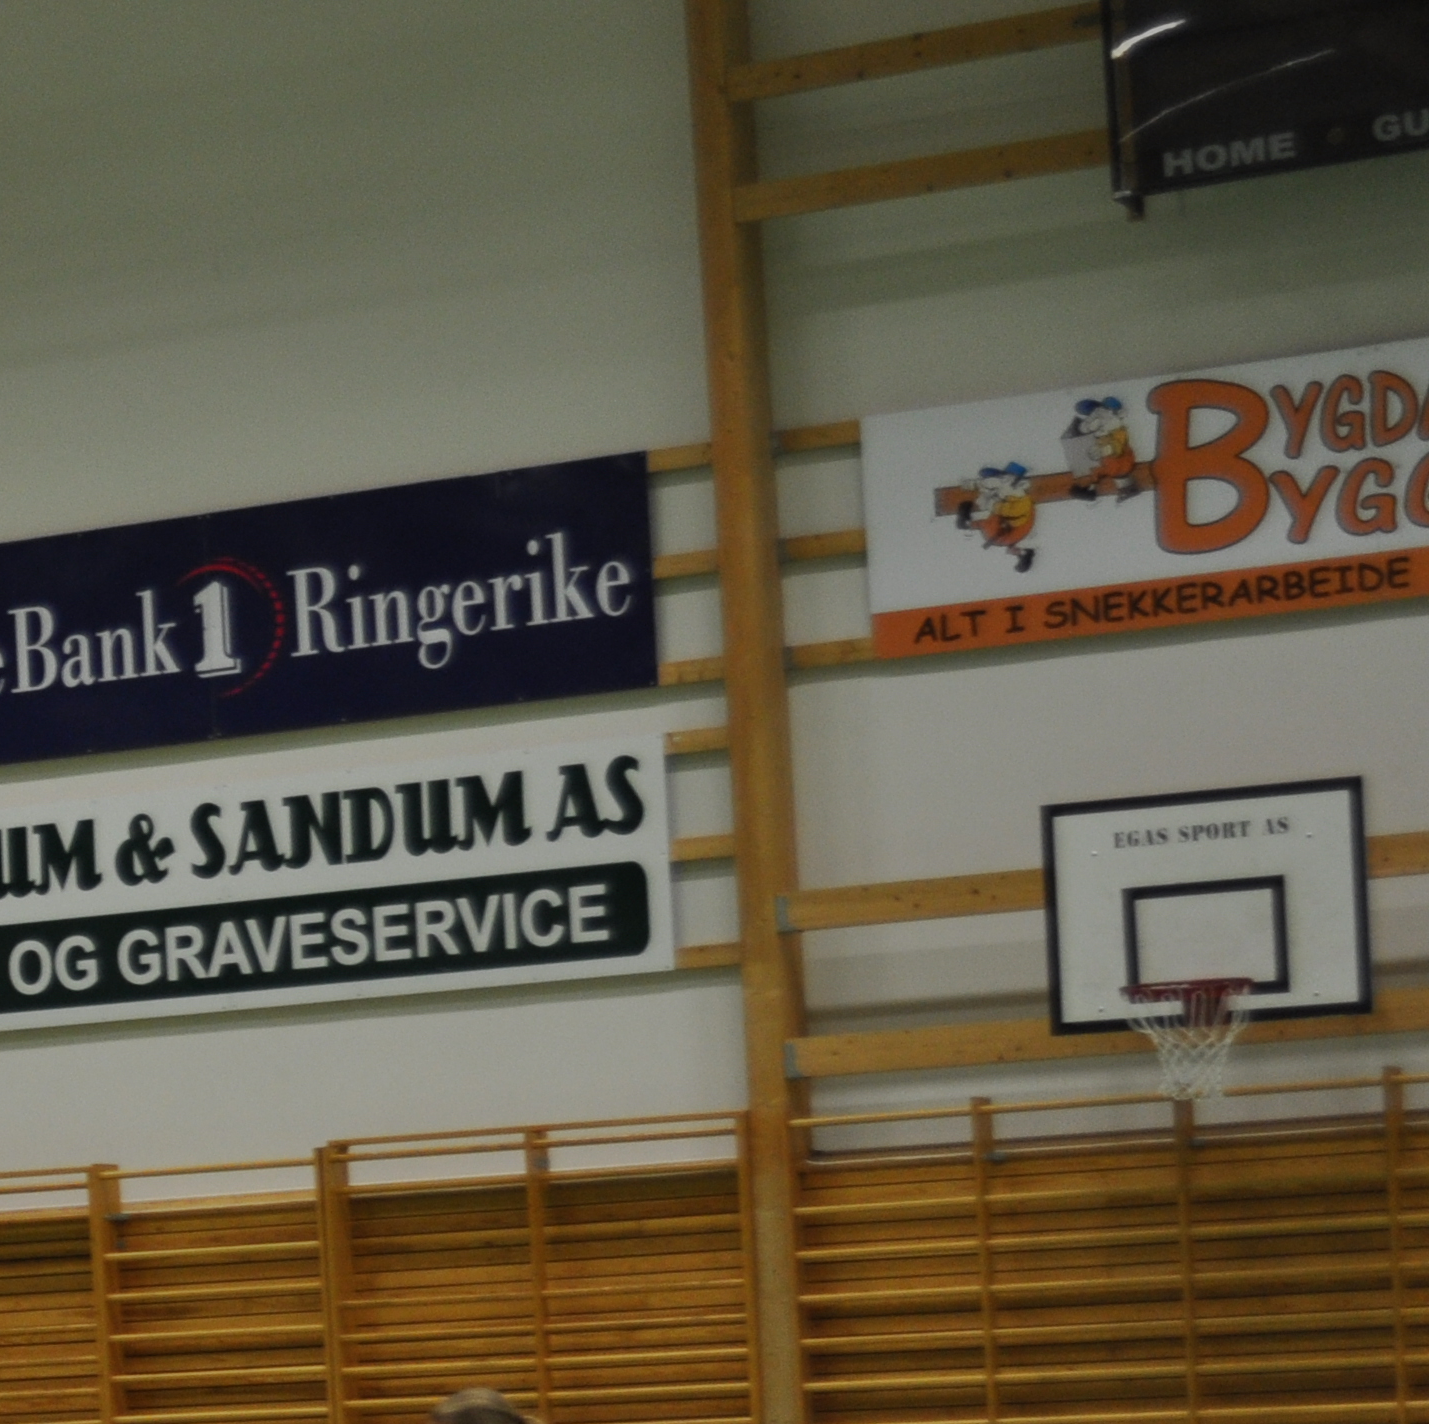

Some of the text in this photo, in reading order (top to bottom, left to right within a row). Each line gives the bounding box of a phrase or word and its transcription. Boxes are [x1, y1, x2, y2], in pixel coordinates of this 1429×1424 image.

[1162, 132, 1296, 178] HOME
[194, 581, 240, 678] 1
[287, 531, 633, 671] Ringerike
[913, 556, 1411, 645] ALT I SNEKKERARBEIDE
[115, 812, 176, 887] &
[189, 768, 532, 880] SANDUM
[546, 754, 644, 843] AS
[1113, 816, 1292, 849] EGAS SPORT AS
[8, 932, 99, 997] OG
[117, 882, 611, 986] GRAVESERVICE
